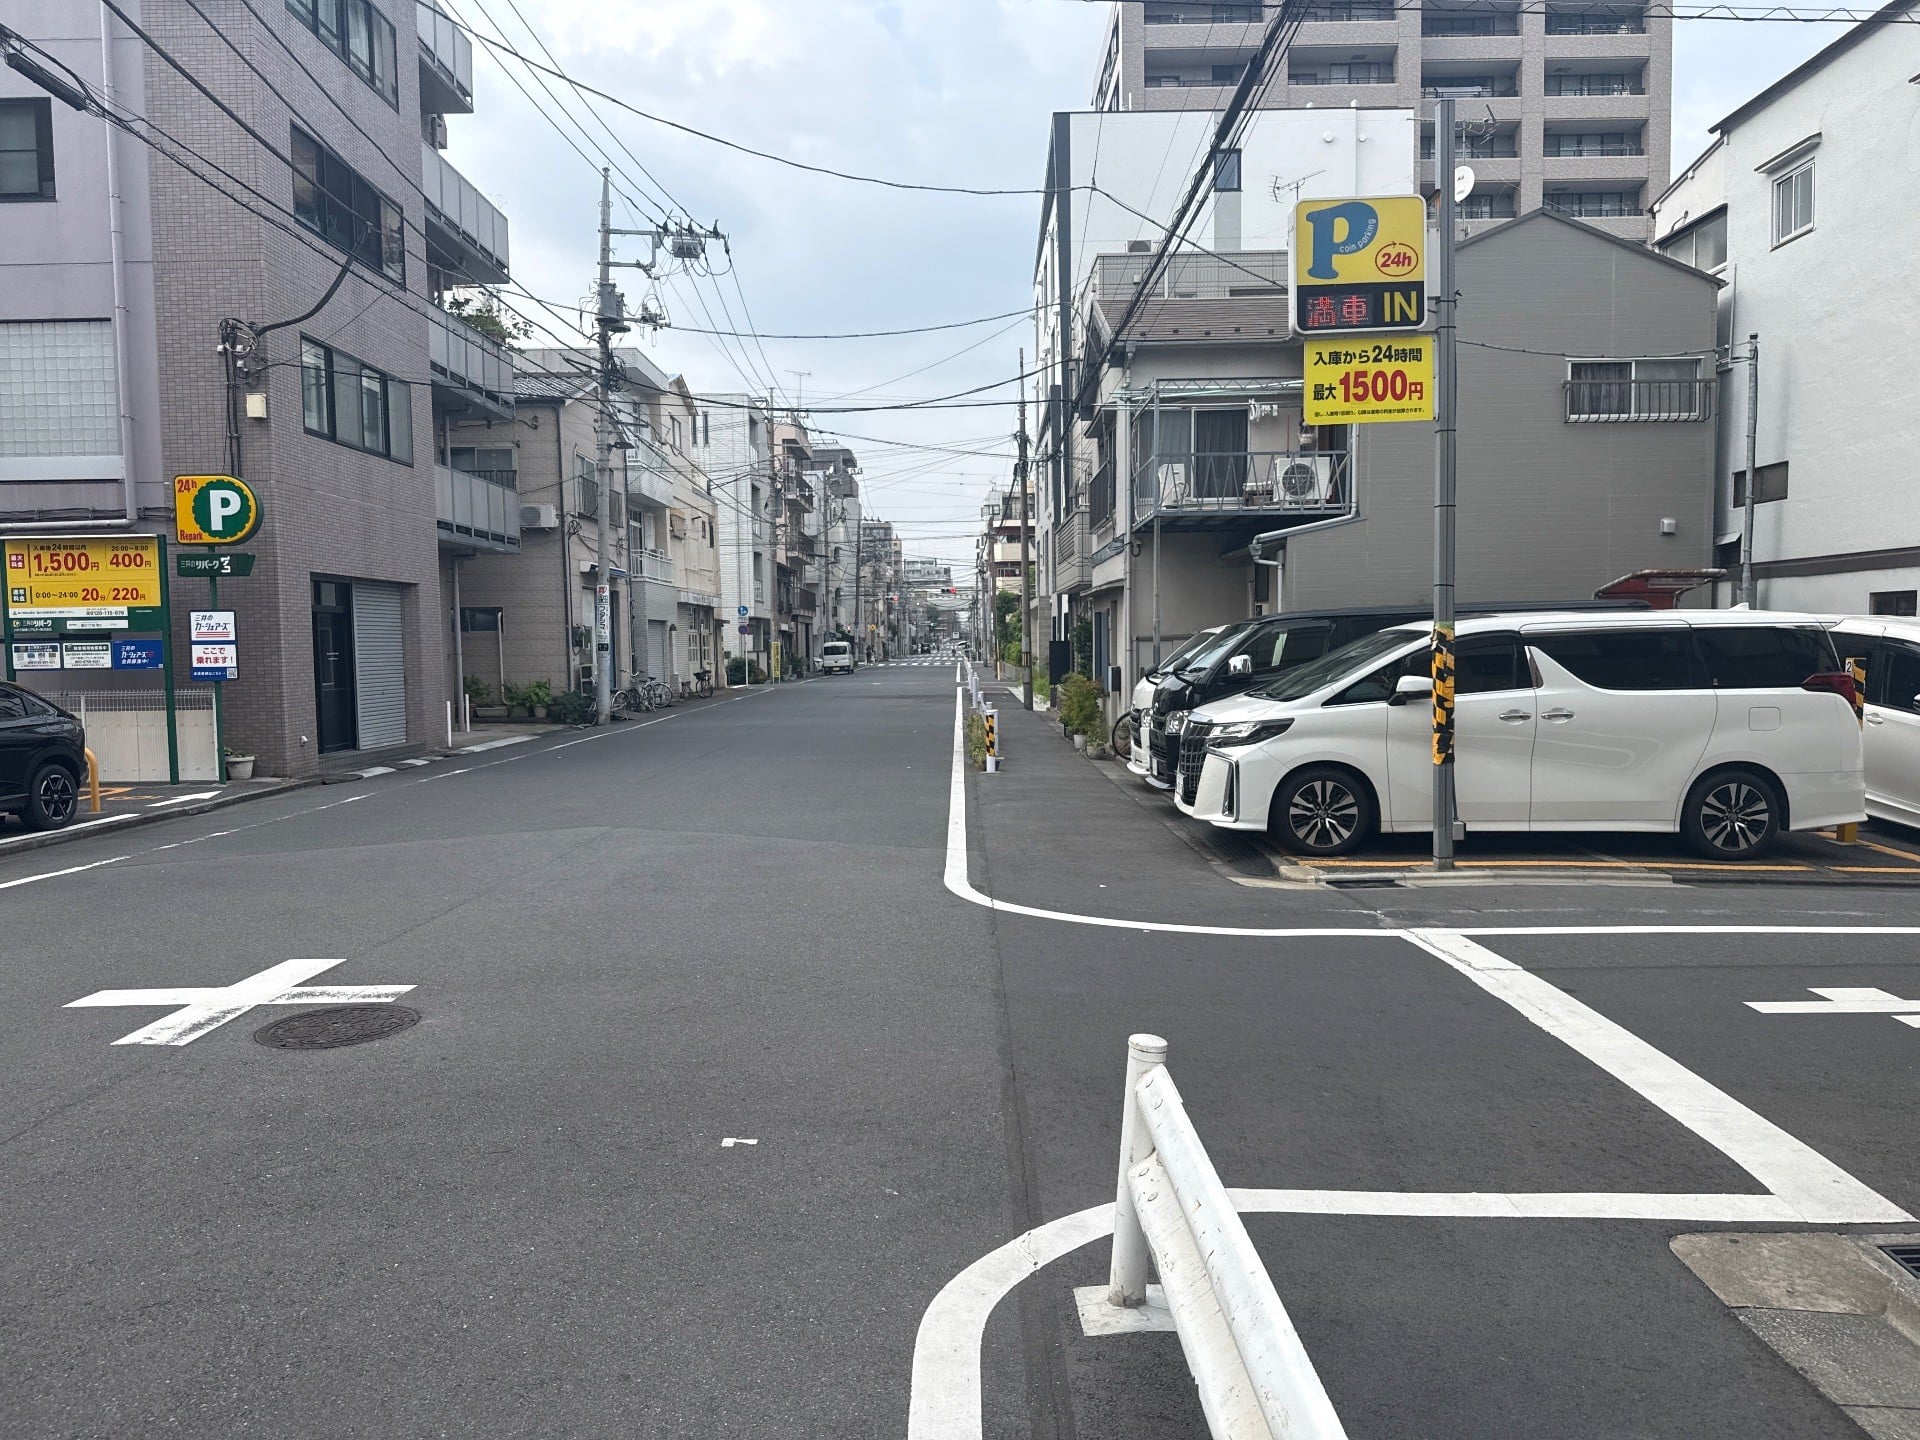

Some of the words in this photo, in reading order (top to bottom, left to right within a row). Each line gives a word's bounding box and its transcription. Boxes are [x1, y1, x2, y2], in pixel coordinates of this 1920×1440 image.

[1306, 201, 1378, 279] P
[1340, 244, 1356, 253] coin
[1357, 218, 1376, 248] parking
[1380, 252, 1412, 268] 24h
[1306, 295, 1368, 326] 満車
[1384, 291, 1417, 322] IN
[1314, 345, 1422, 366] 入庫から24時間
[178, 480, 197, 492] 24h
[209, 490, 242, 531] P
[180, 530, 203, 542] Repark
[33, 552, 100, 572] 1,500円
[109, 553, 152, 568] 400円
[181, 560, 219, 569] 三井のリパーク
[194, 622, 231, 631] カーシェアーズ
[202, 647, 226, 655] ここで
[1846, 661, 1852, 673] 2
